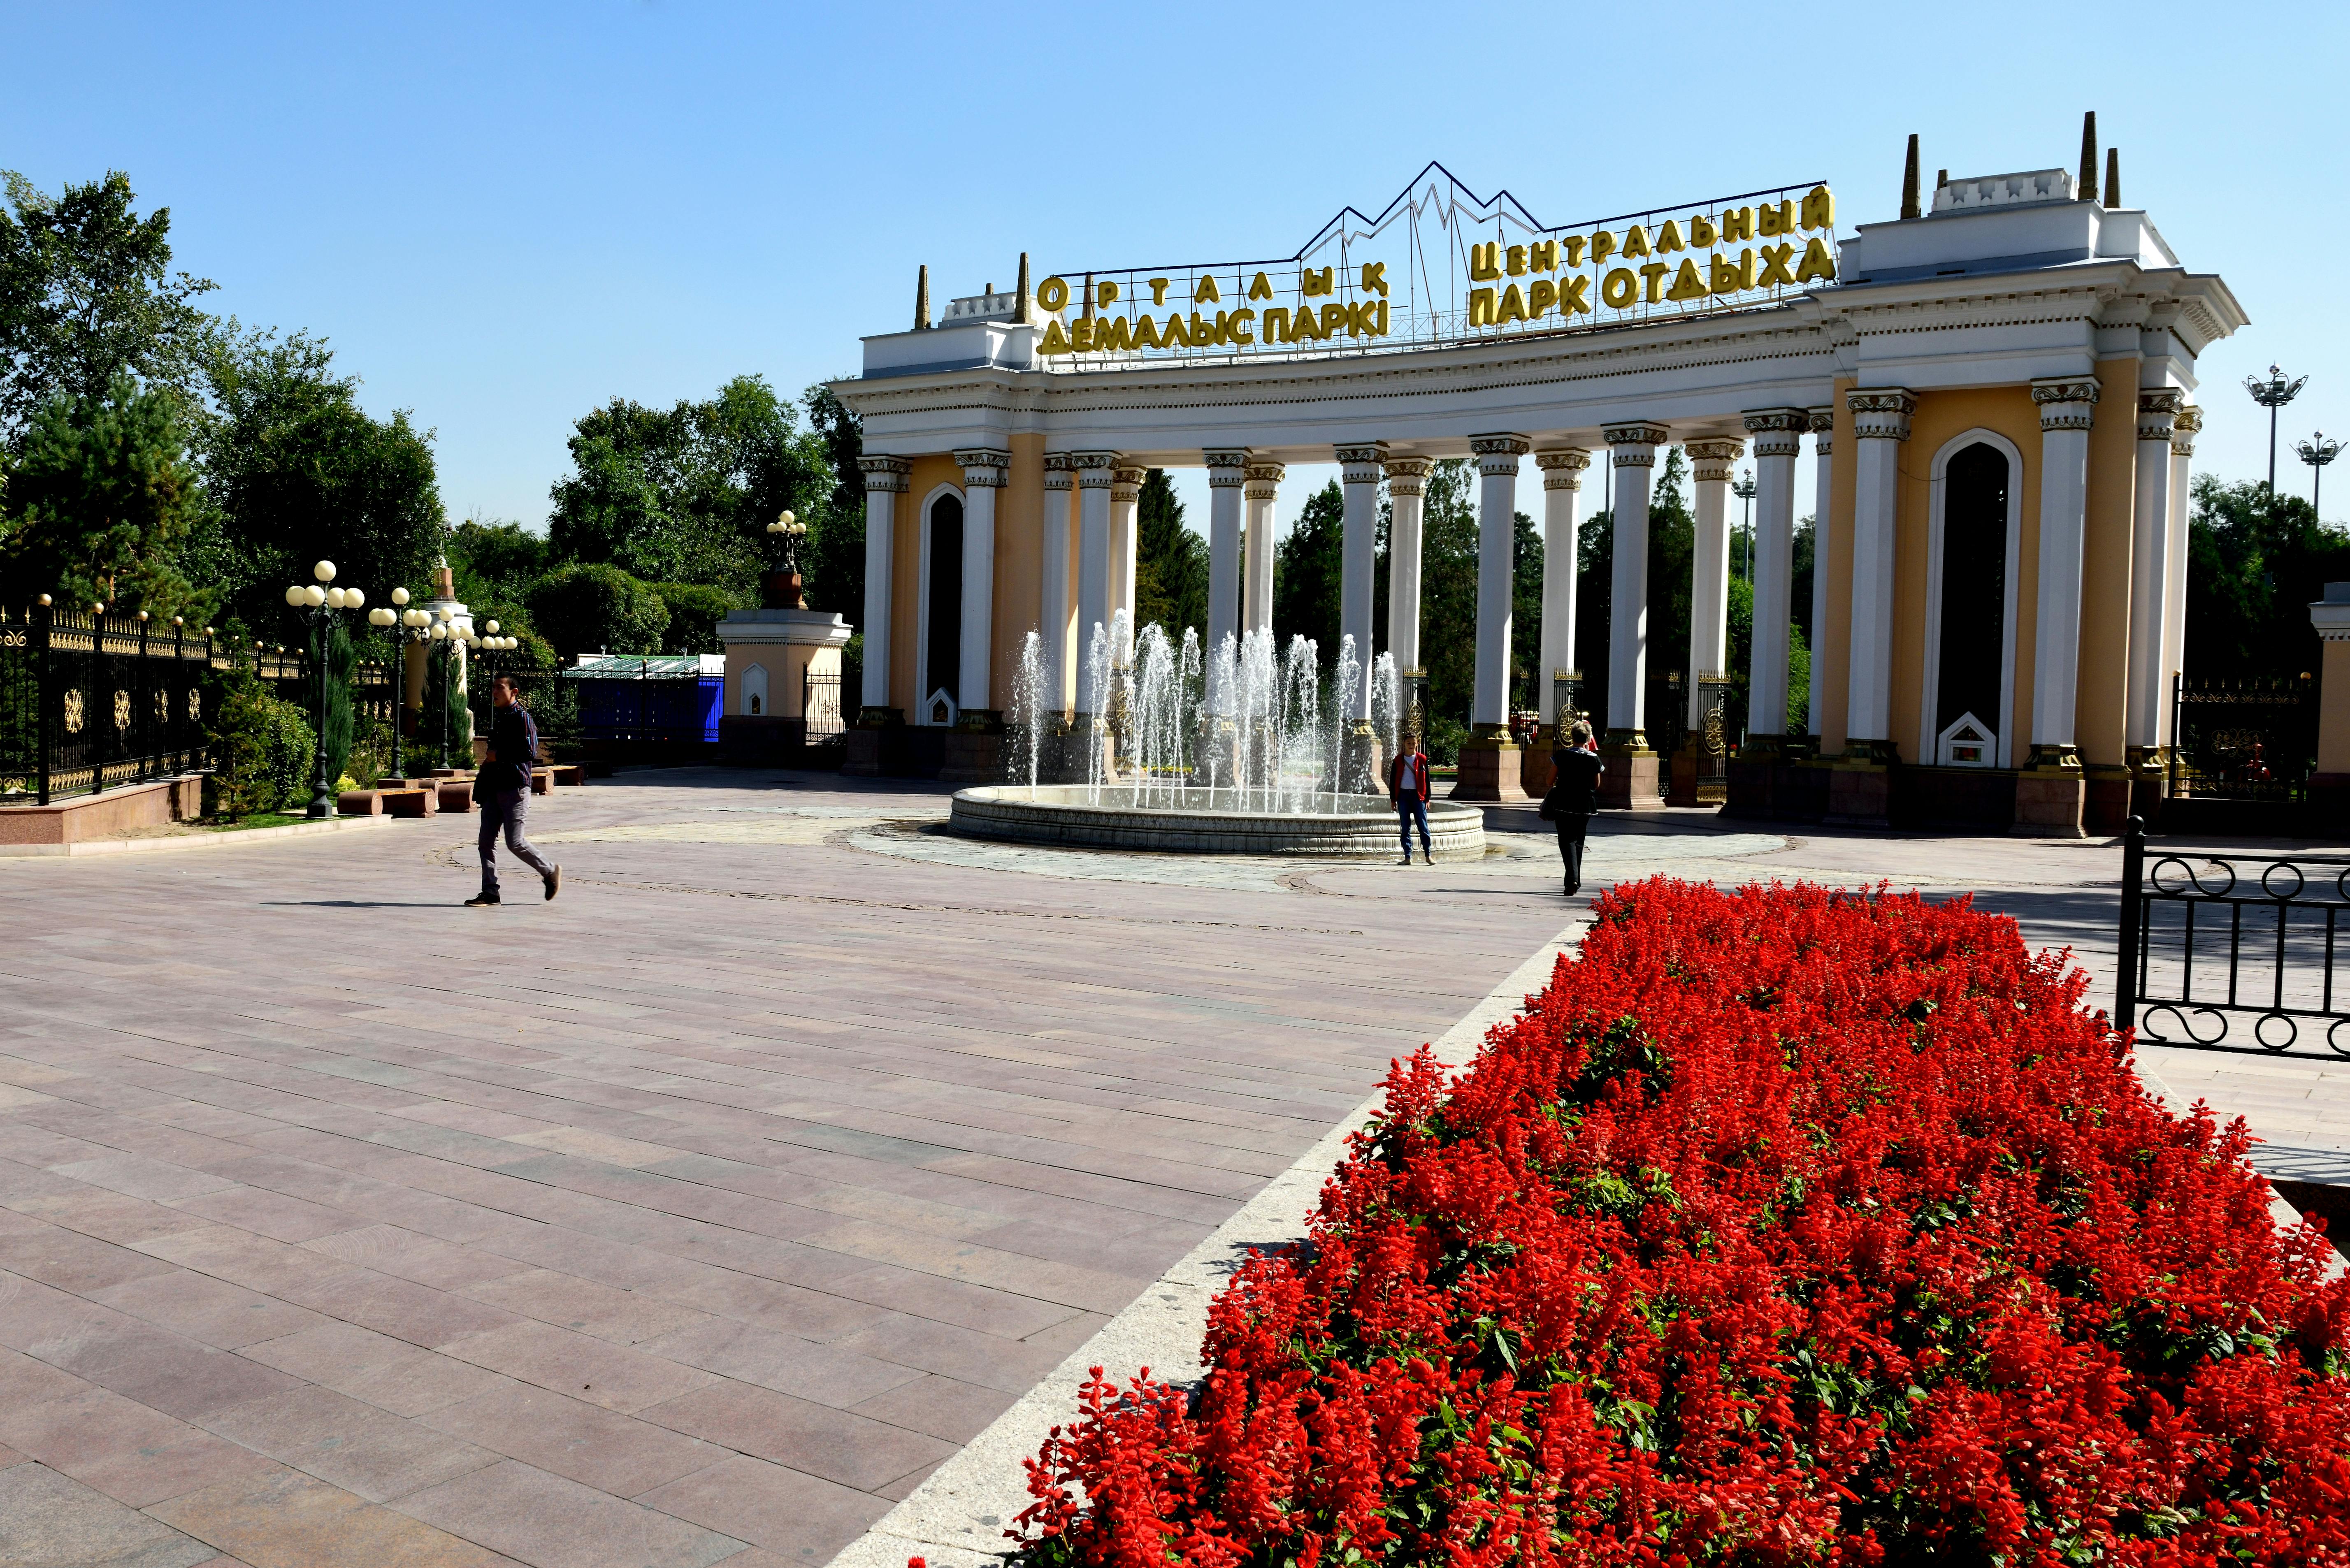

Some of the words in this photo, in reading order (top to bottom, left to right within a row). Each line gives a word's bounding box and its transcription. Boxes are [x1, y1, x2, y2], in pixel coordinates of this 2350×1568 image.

[1471, 186, 1835, 282] ЦЕНТРАЛЬНЫЙ
[1036, 304, 1257, 355] ДЕМАЛЫС
[1263, 299, 1390, 344] ПАРКІ
[1469, 275, 1591, 327] ПАРК
[1602, 237, 1836, 308] ОТДЫХА
